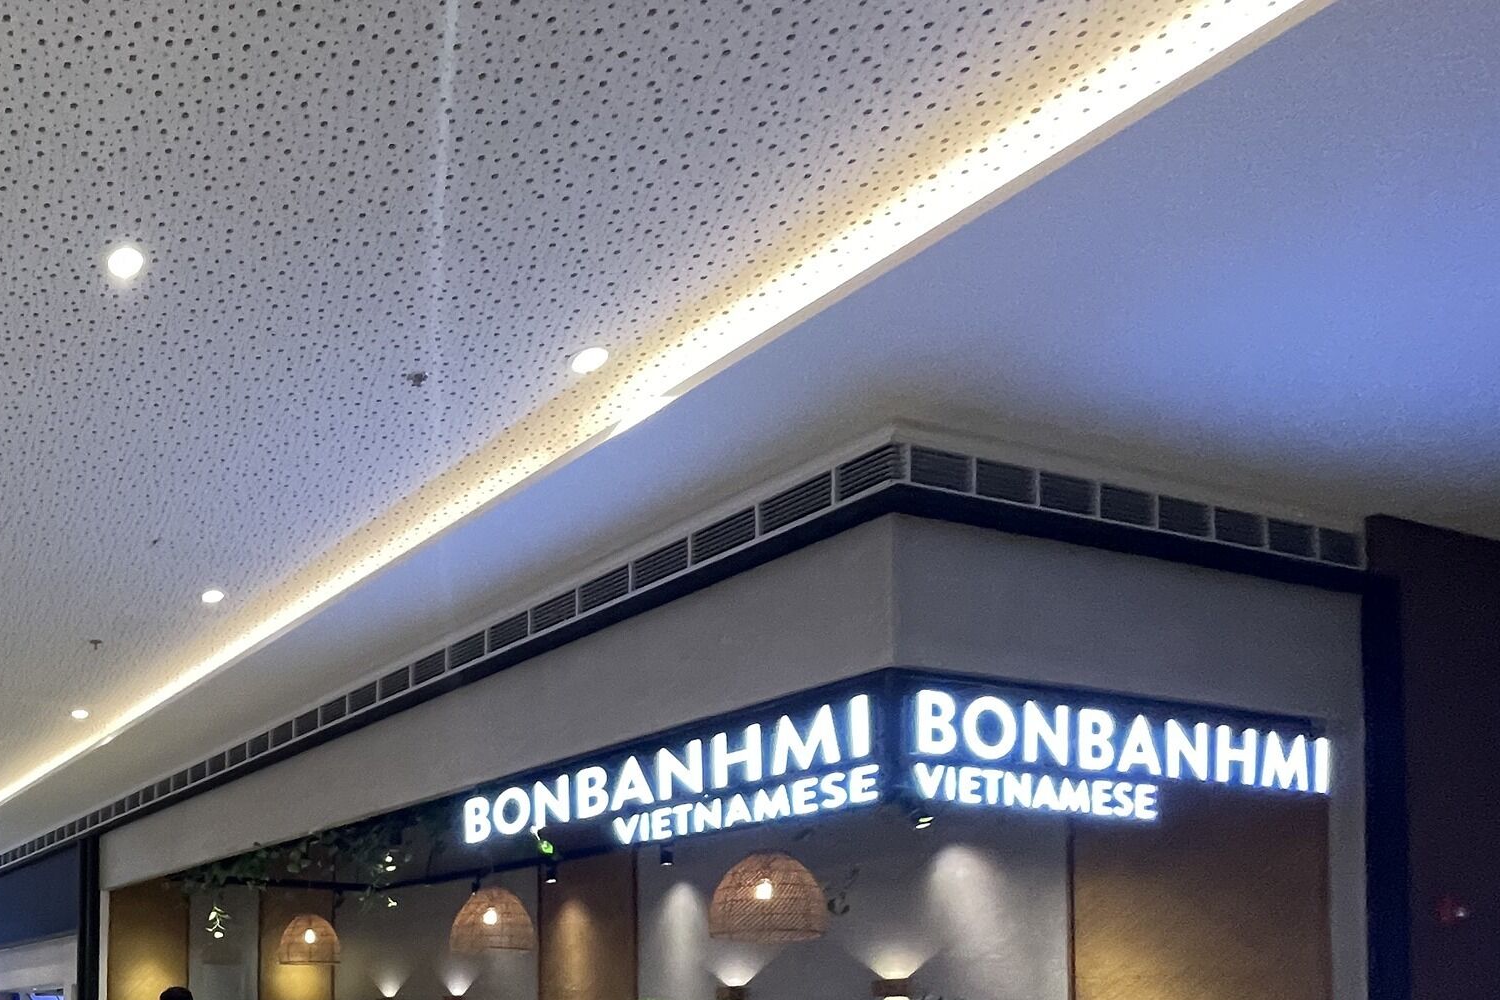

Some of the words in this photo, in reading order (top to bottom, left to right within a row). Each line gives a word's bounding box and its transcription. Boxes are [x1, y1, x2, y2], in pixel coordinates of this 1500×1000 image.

[463, 693, 871, 845] BONBANHMI
[915, 688, 1332, 795] BONBANHMI
[612, 764, 880, 846] VIETNAMESE
[913, 761, 1159, 821] VIETNAMESE
